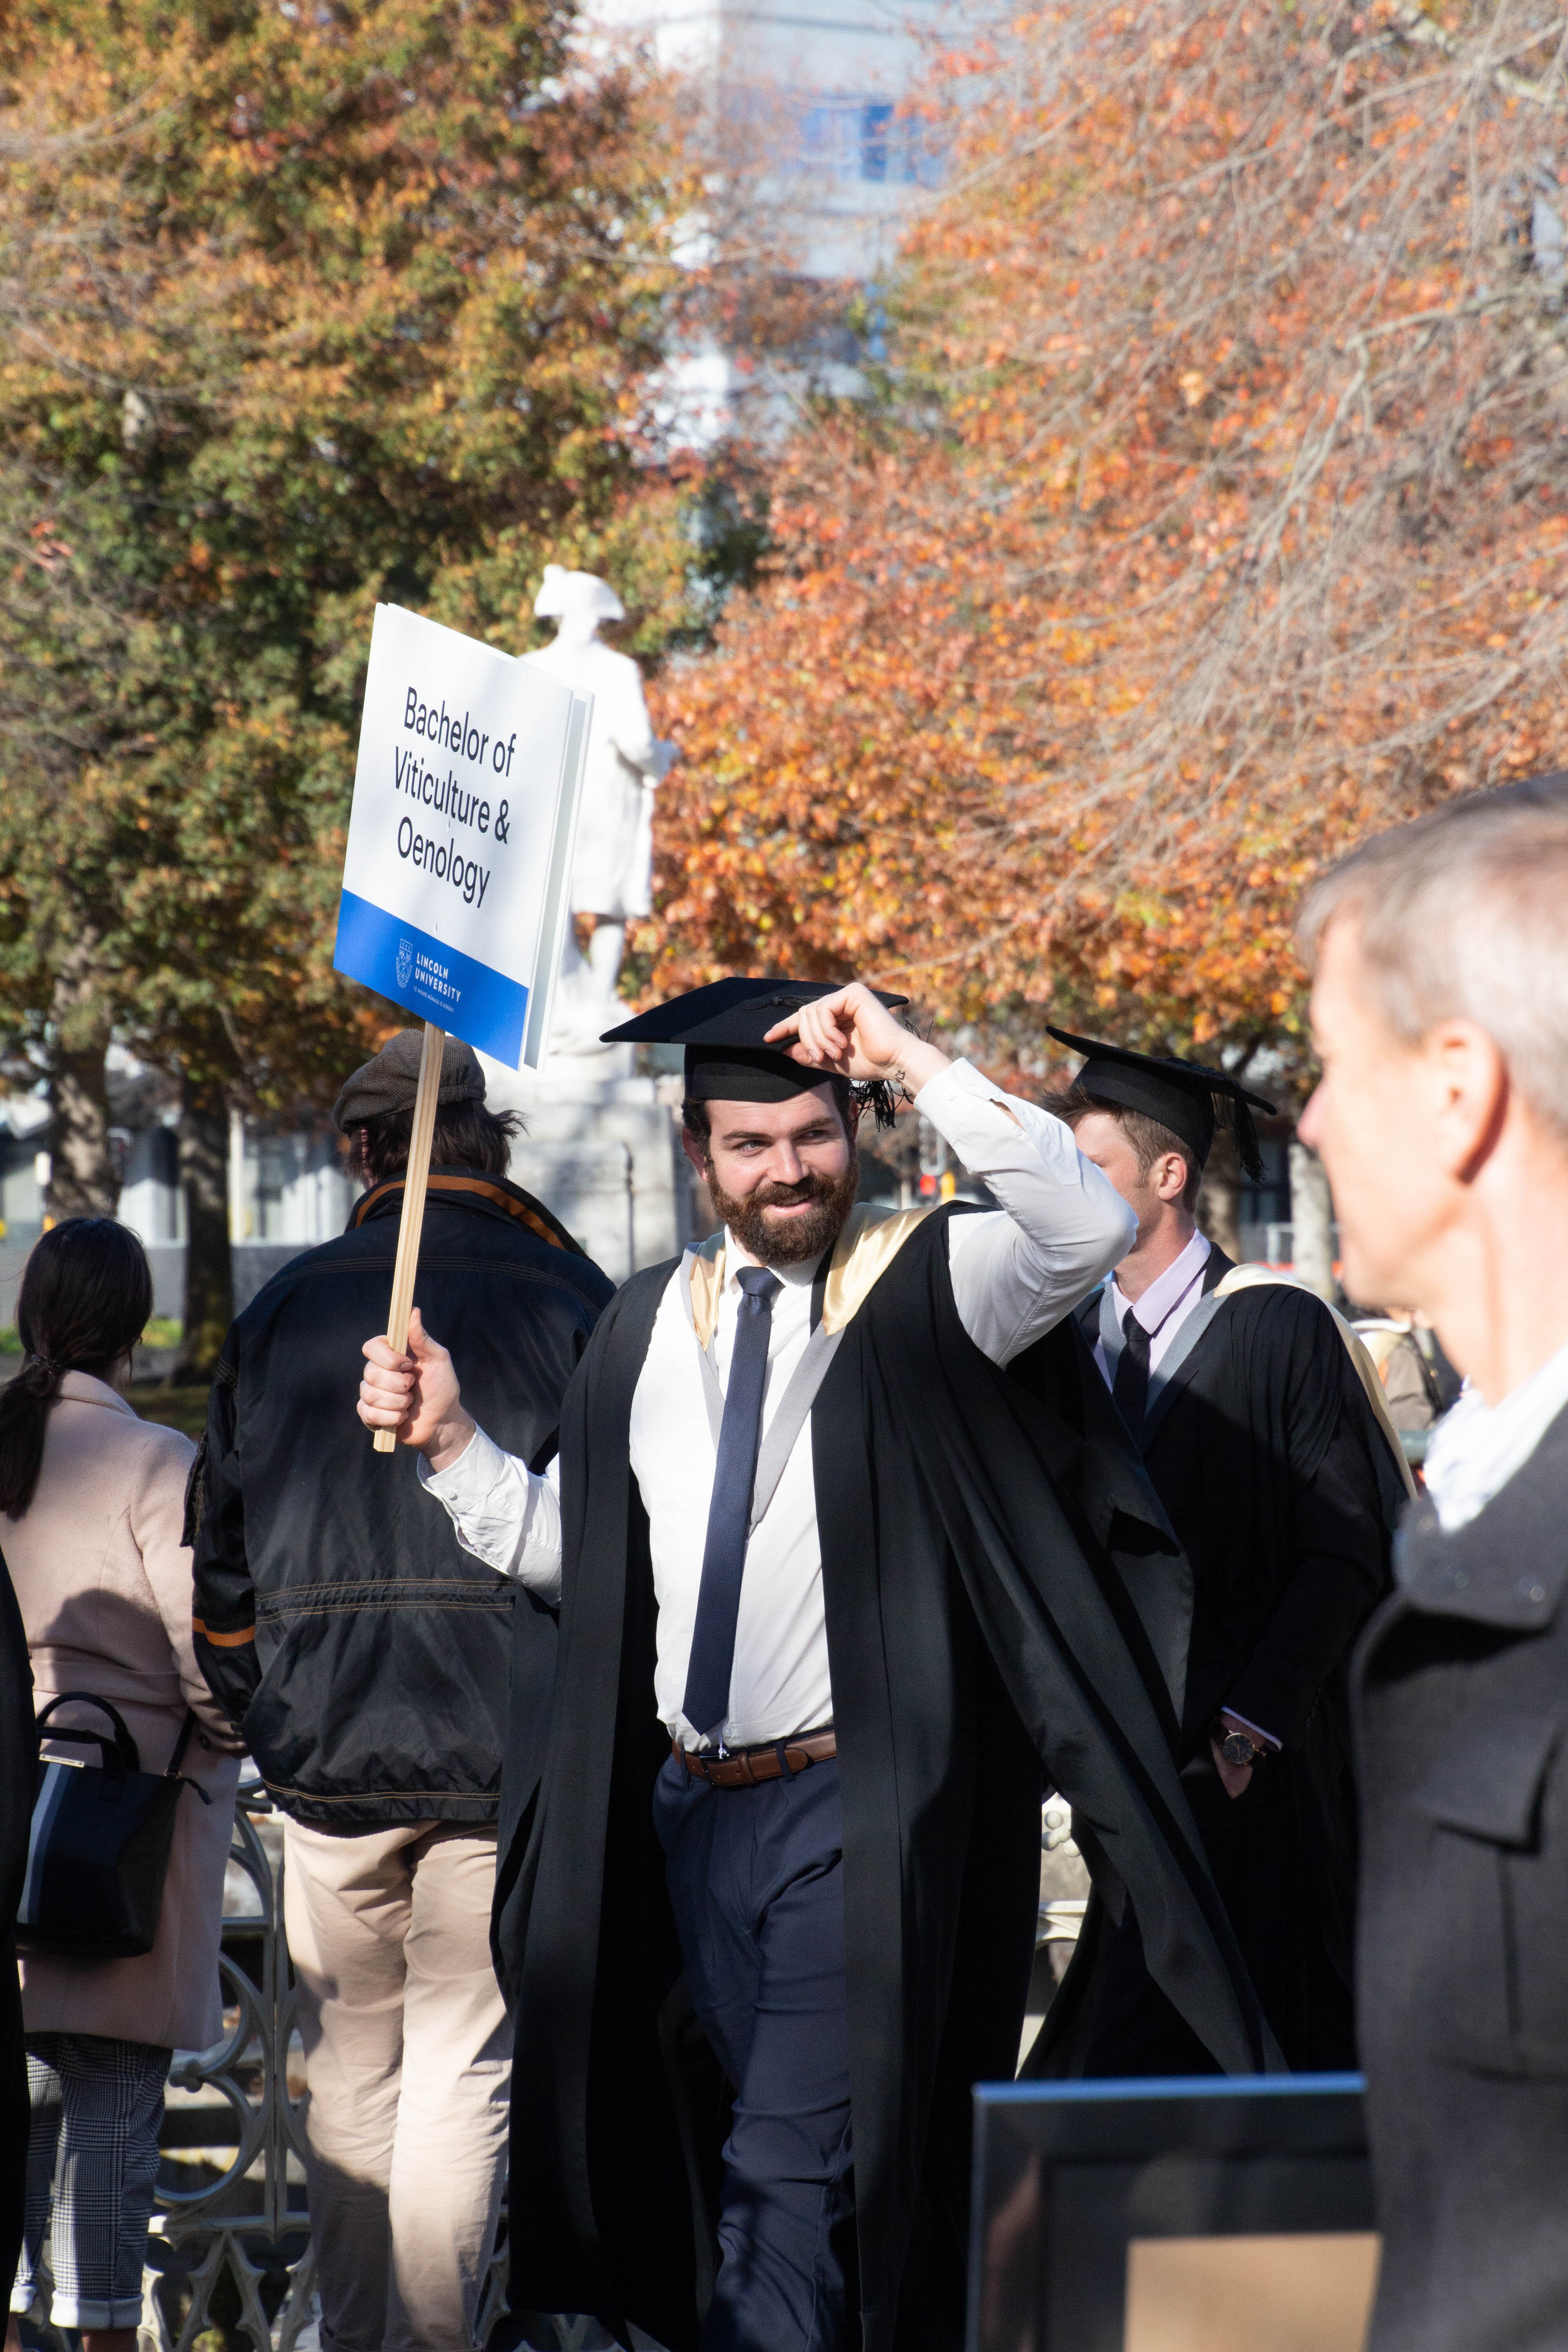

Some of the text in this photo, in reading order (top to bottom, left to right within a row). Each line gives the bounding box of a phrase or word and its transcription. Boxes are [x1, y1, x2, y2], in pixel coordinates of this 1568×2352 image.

[404, 686, 517, 777] Bachelor of
[396, 746, 510, 845] Viticulture &
[398, 816, 491, 909] Oenology
[415, 967, 461, 1002] UNIVERSITY
[416, 952, 448, 980] LINCOLN
